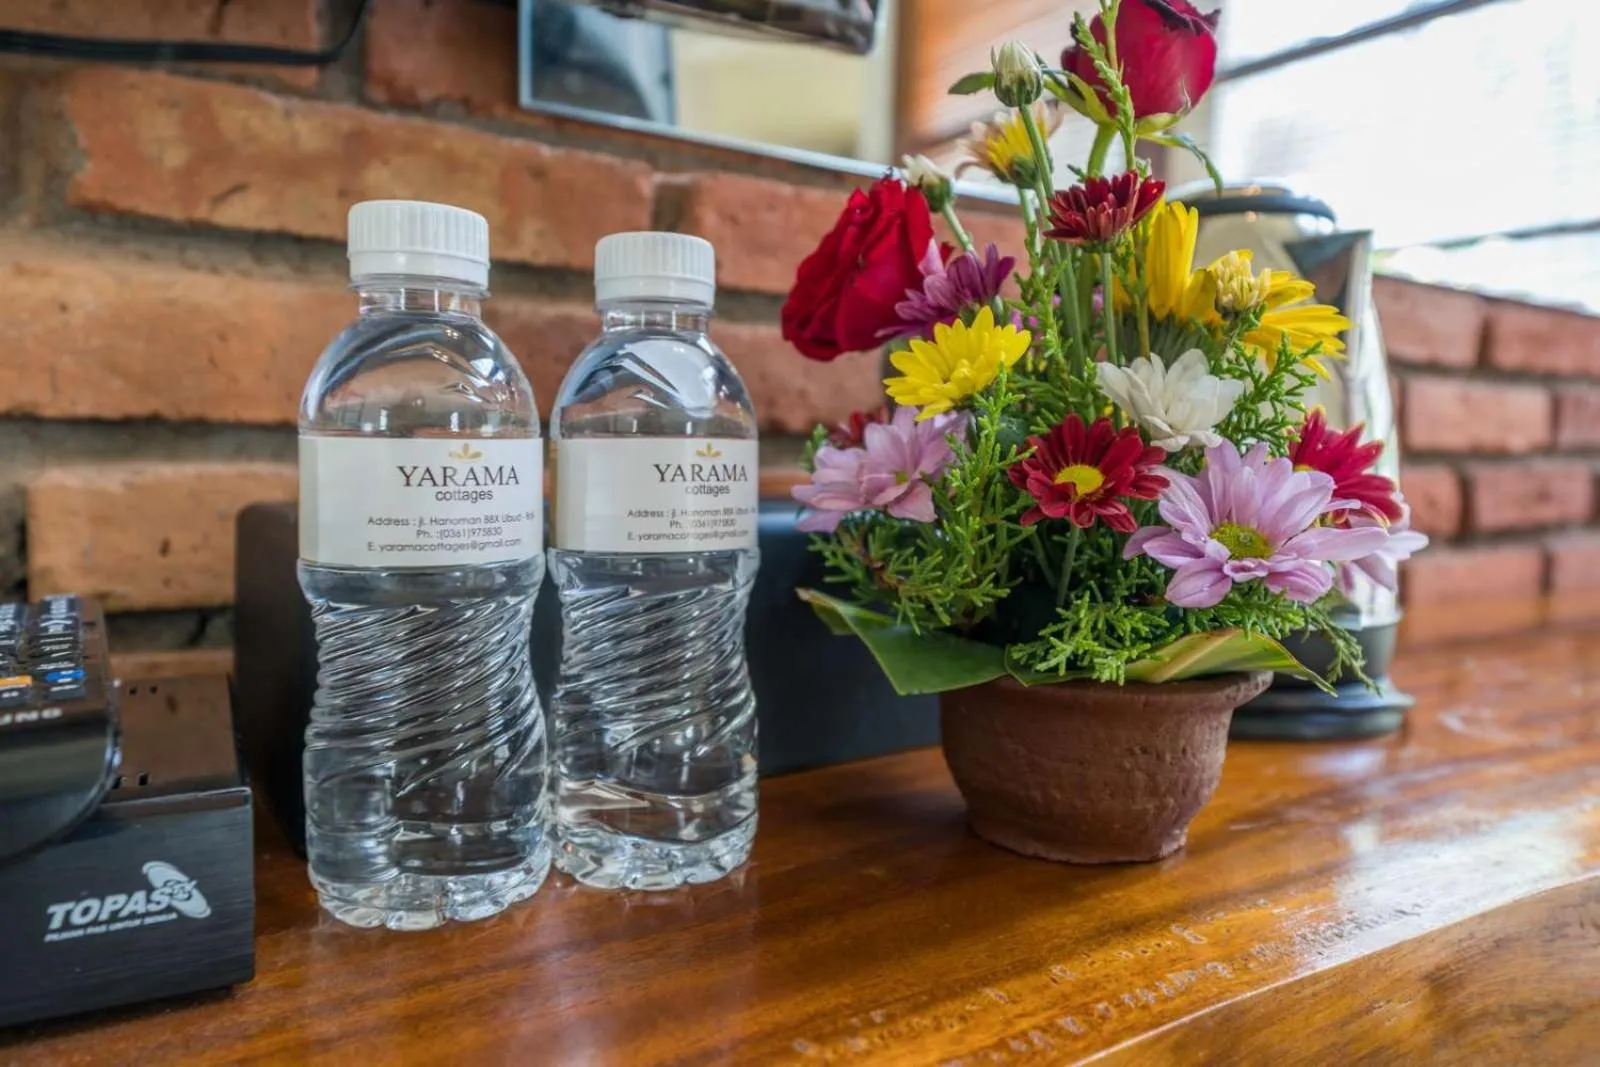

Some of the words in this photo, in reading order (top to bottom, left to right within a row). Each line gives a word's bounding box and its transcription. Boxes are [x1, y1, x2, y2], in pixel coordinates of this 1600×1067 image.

[396, 464, 520, 487] YARAMA
[653, 463, 748, 483] YARAMA
[435, 489, 494, 504] cottages
[685, 483, 731, 498] cottages
[367, 515, 411, 526] Address
[430, 515, 482, 526] Hanoman
[627, 508, 664, 518] Address
